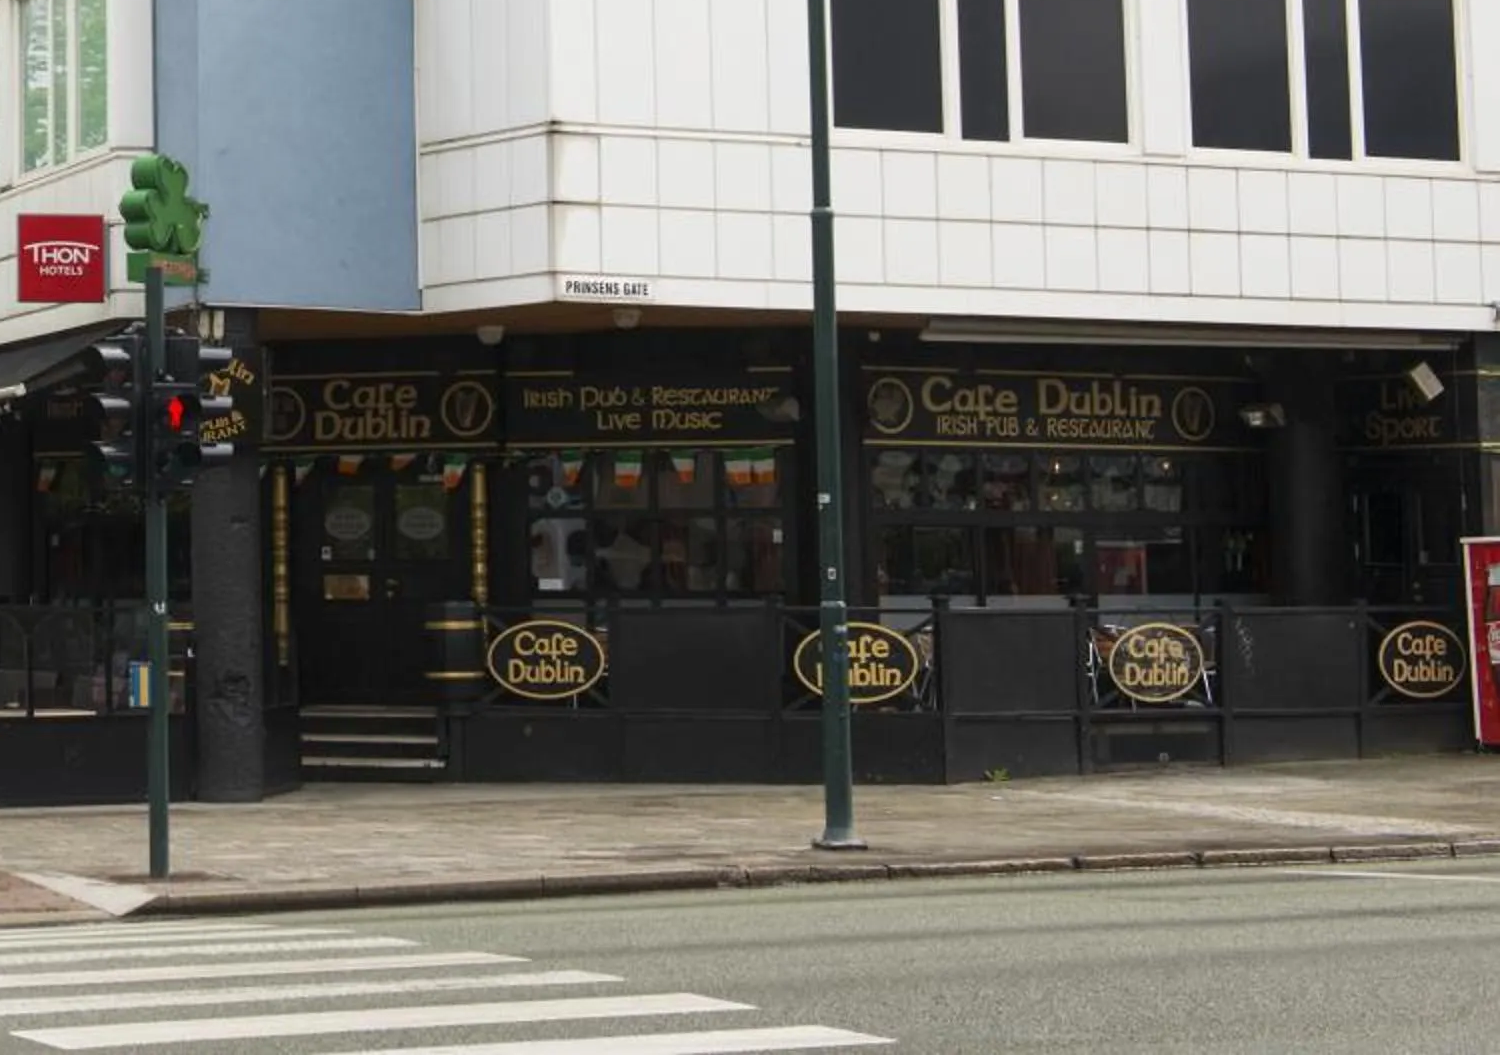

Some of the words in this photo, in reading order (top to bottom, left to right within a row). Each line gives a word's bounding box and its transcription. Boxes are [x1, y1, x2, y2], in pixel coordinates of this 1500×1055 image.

[23, 240, 99, 264] THON
[39, 265, 84, 277] HOTELS
[565, 280, 620, 295] PRINSENS
[623, 282, 649, 296] GATE
[323, 379, 418, 415] Cafe
[631, 387, 646, 406] &
[921, 375, 1018, 421] Cafe
[1037, 377, 1162, 418] Dublin
[314, 409, 431, 440] Dublin
[936, 415, 978, 435] IRISH
[985, 417, 1021, 437] PUB
[1026, 419, 1039, 437] &
[1047, 418, 1155, 440] RESTAURANT
[514, 630, 578, 661] Cafe
[817, 634, 889, 663] afe
[1129, 634, 1183, 664] Cafe
[1397, 632, 1446, 661] Cafe
[508, 658, 586, 683] Dublin
[816, 662, 902, 687] blin
[1125, 662, 1188, 686] Dublin
[1392, 658, 1454, 682] Dublin
